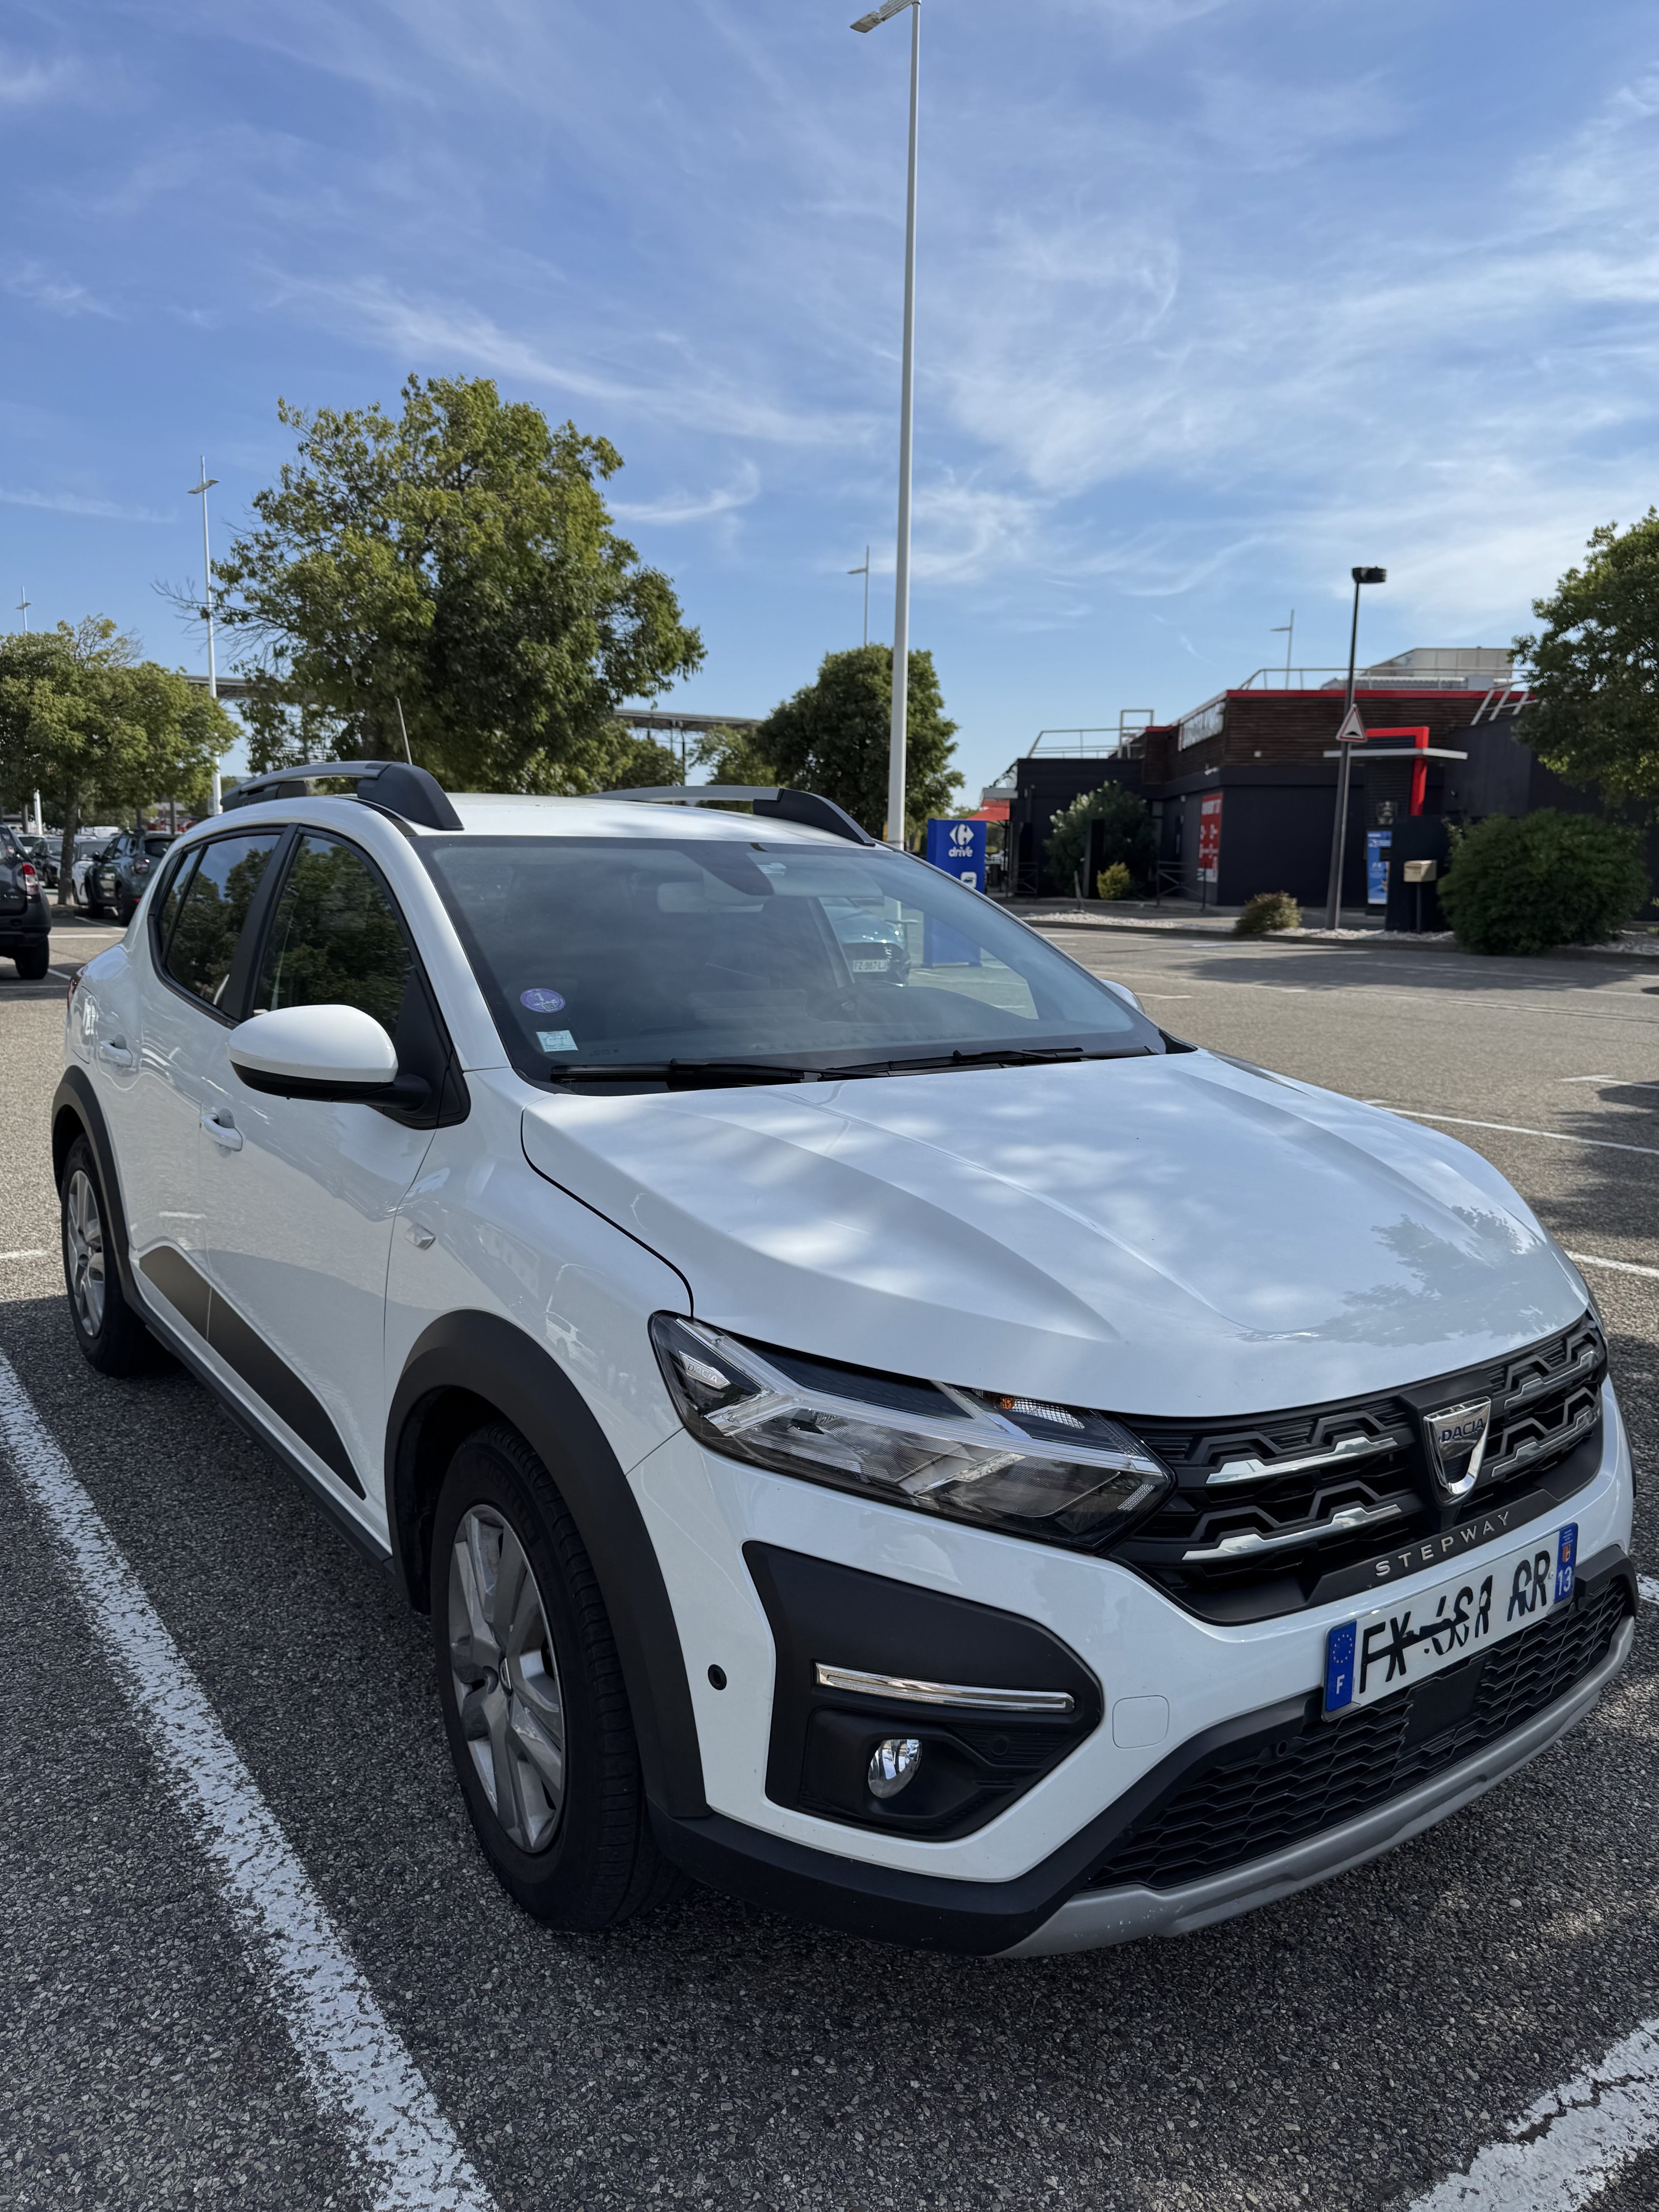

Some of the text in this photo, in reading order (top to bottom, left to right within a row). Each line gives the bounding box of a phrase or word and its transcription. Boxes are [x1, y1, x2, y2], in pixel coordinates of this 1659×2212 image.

[948, 846, 973, 857] drive
[687, 1363, 718, 1384] DACIA
[1441, 1418, 1484, 1443] DACIA
[1375, 1511, 1509, 1577] STEPWAY
[1558, 1566, 1572, 1596] 13
[1336, 1674, 1345, 1695] F
